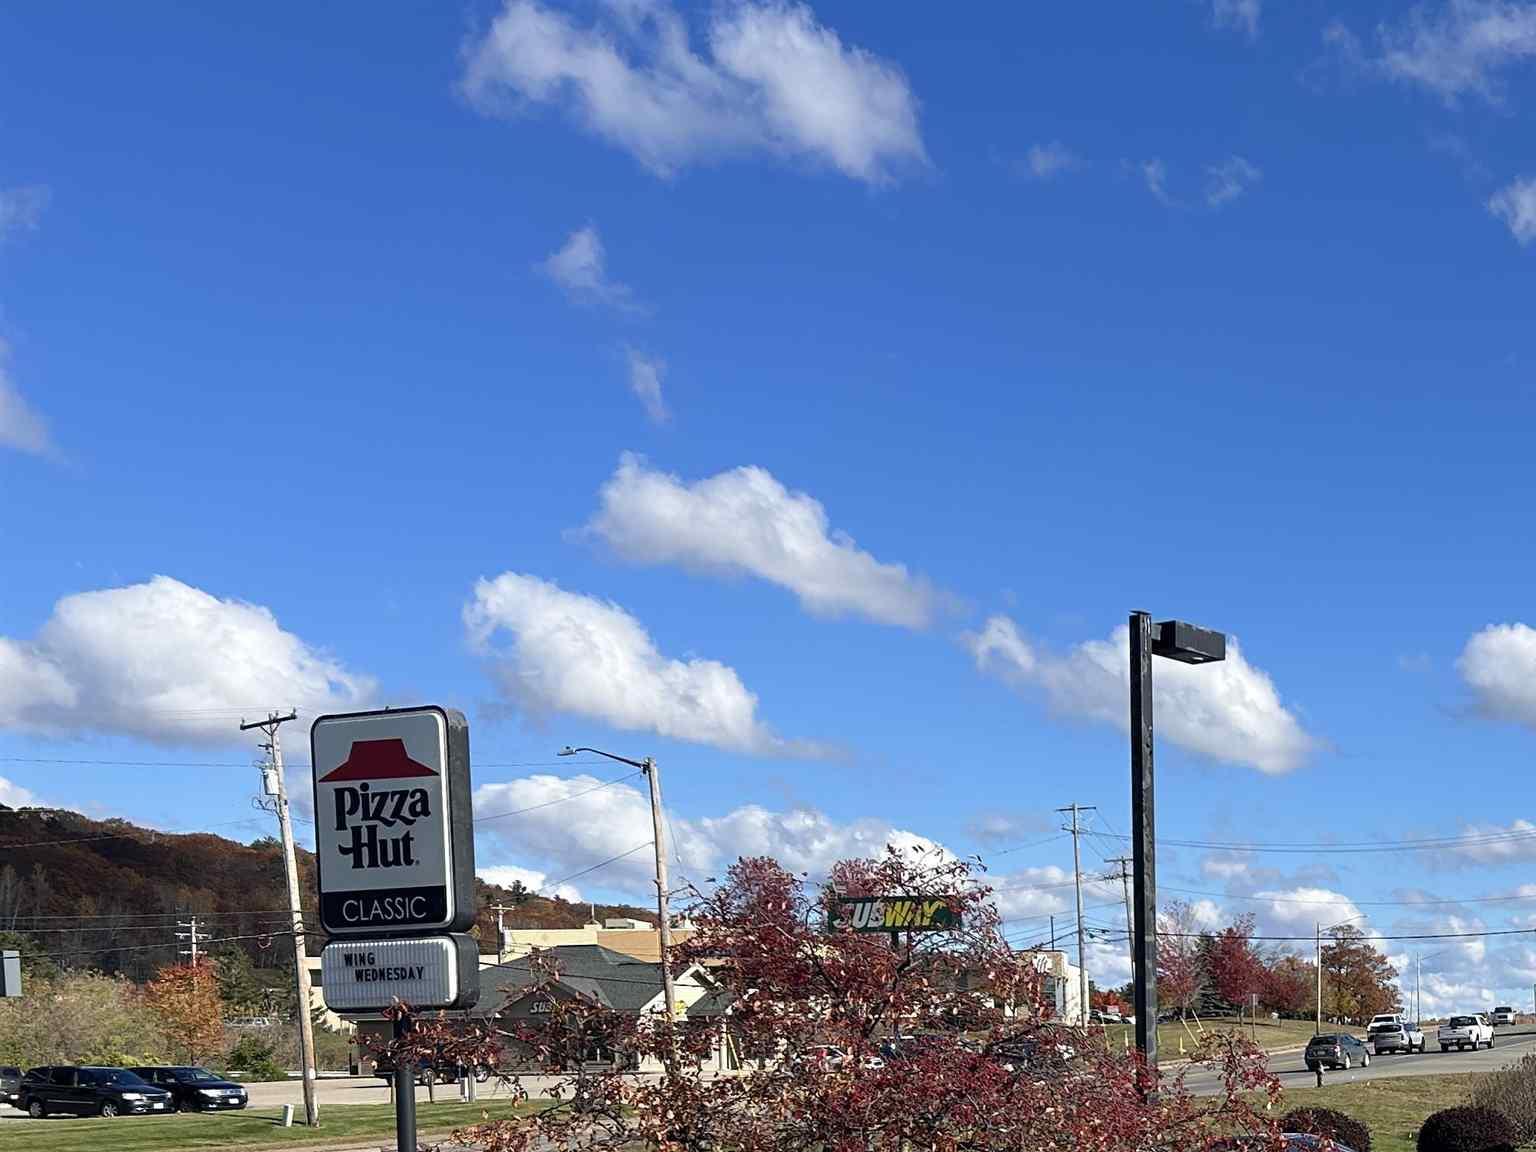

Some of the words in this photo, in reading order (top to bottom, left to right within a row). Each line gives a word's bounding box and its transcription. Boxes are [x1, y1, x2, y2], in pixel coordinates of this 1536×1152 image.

[334, 782, 431, 831] Pizza
[338, 825, 413, 869] Hut
[343, 896, 427, 922] CLASSIC
[343, 952, 376, 967] WING
[355, 966, 424, 982] WEDNESDAY
